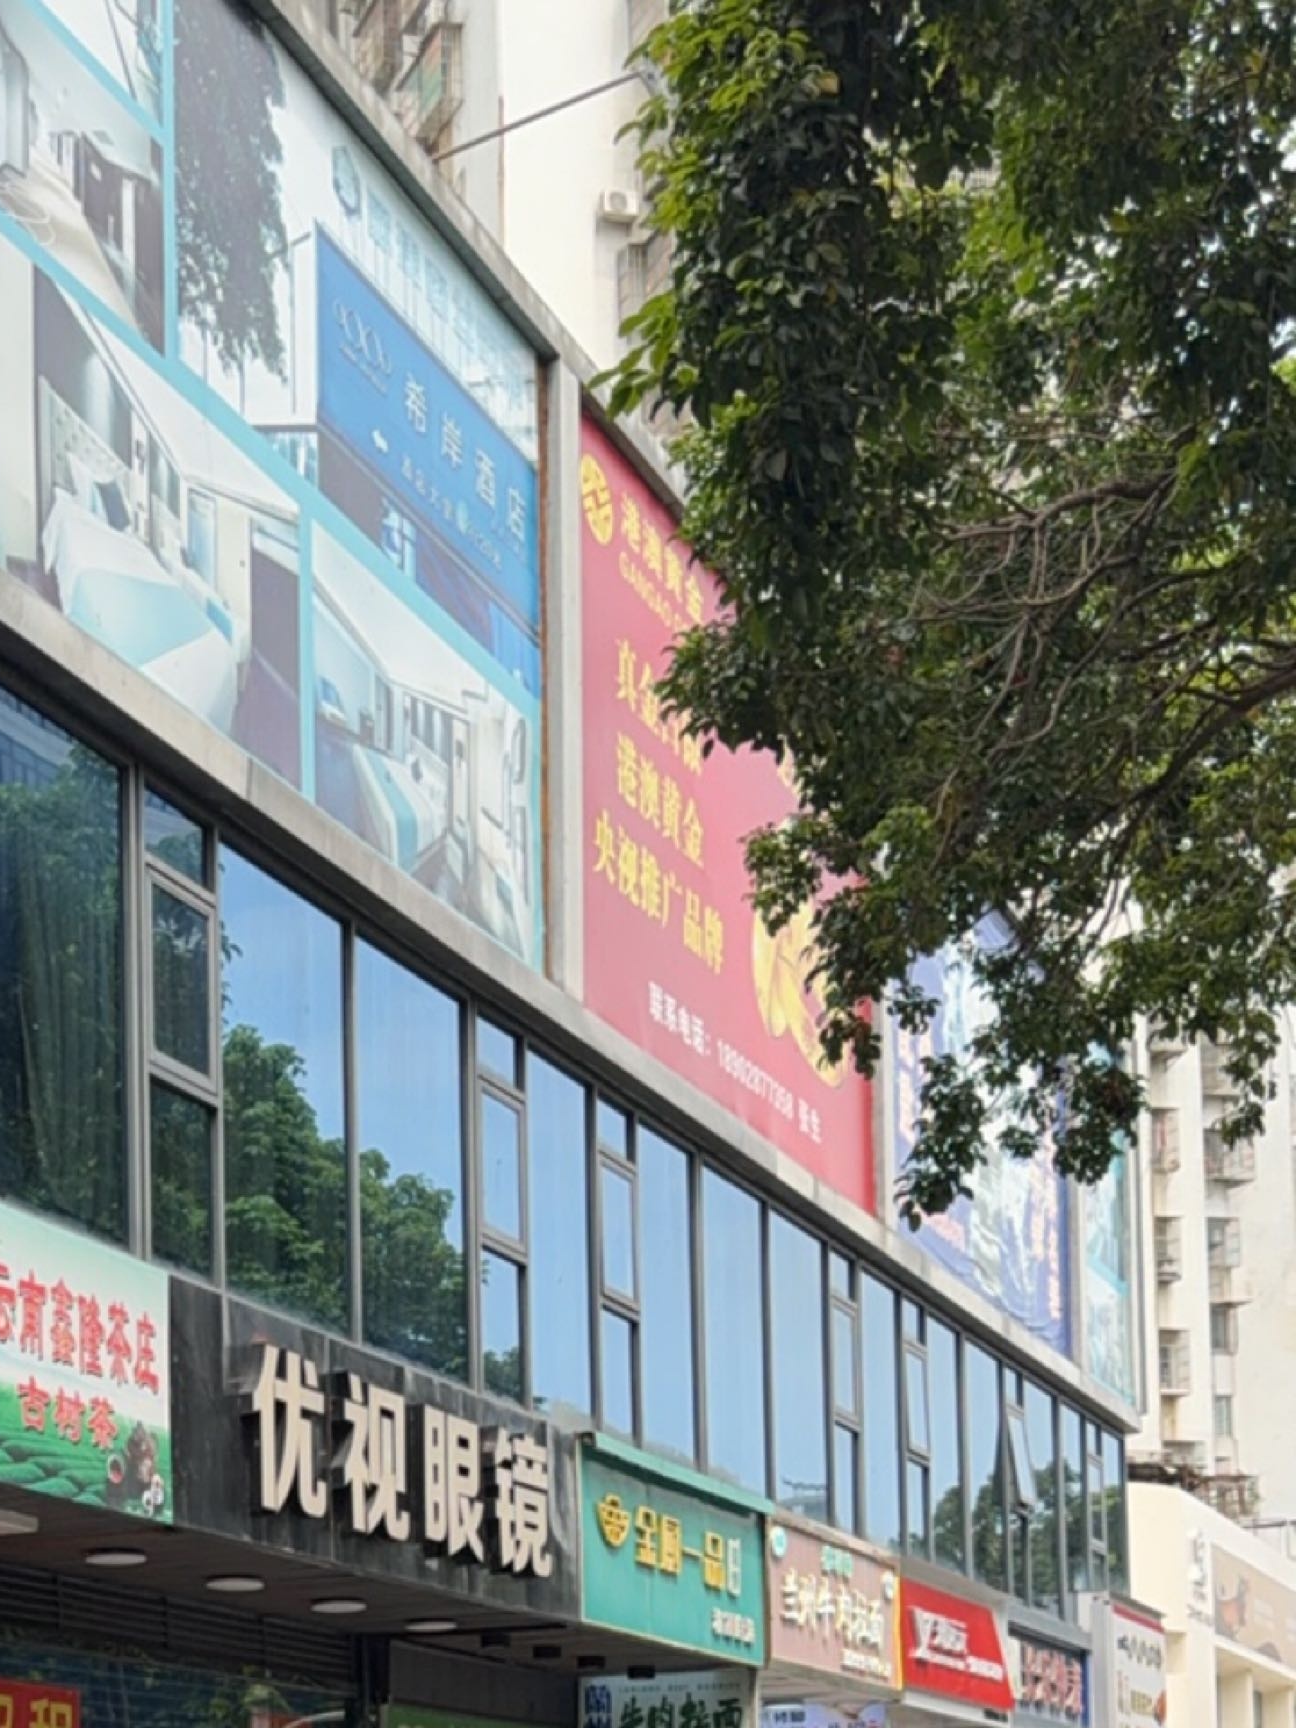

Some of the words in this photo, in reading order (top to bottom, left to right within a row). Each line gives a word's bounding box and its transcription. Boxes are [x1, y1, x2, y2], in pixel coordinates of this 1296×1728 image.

[593, 808, 725, 974] 央视推广品牌
[17, 1374, 117, 1451] 古树茶
[251, 1343, 552, 1578] 优视眼镜
